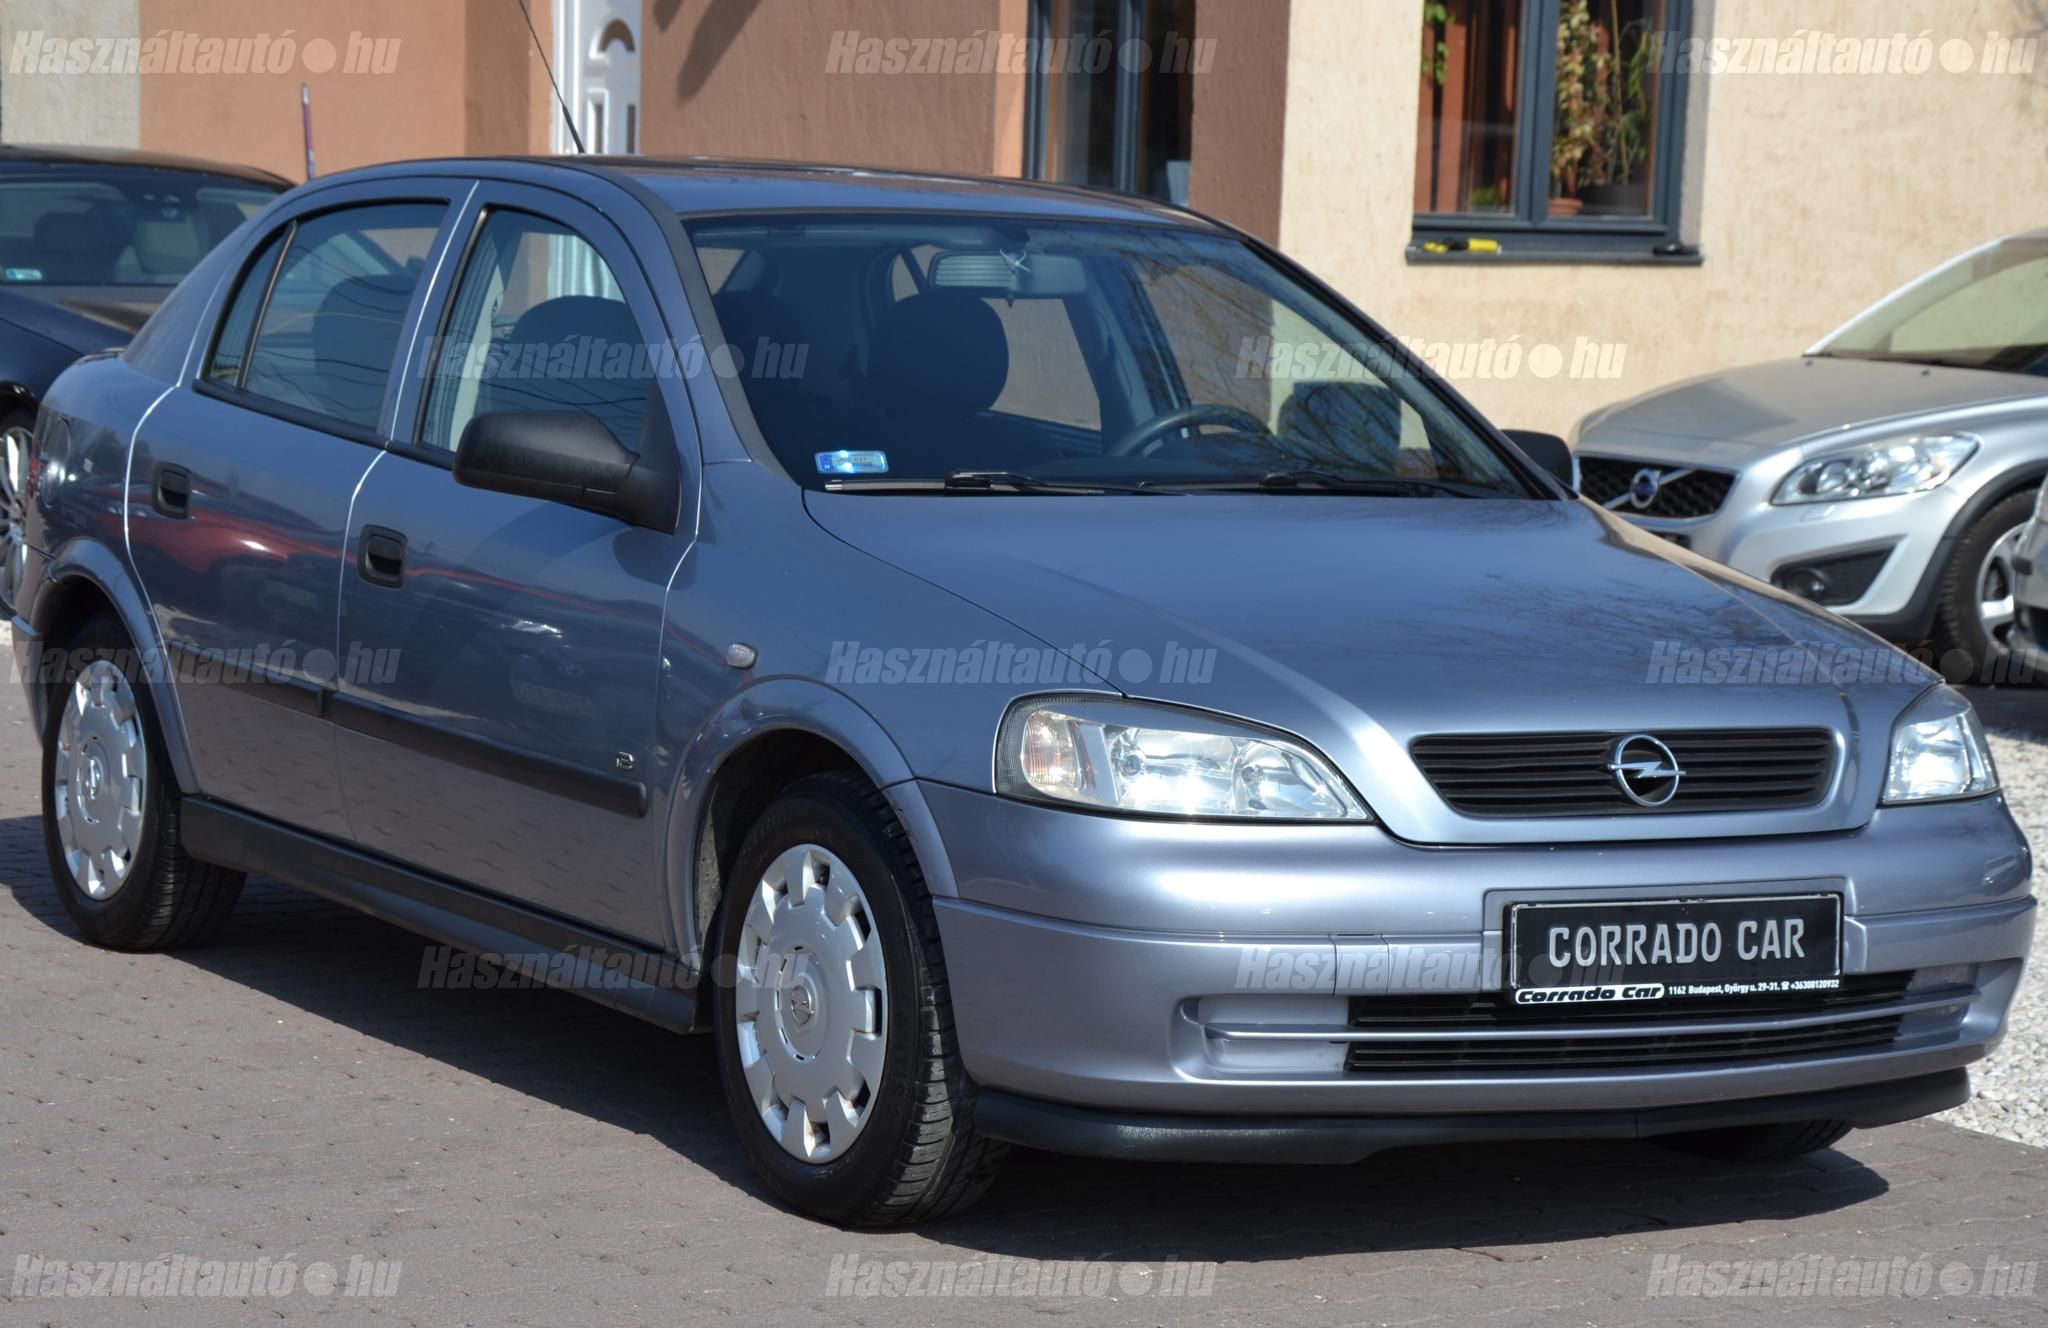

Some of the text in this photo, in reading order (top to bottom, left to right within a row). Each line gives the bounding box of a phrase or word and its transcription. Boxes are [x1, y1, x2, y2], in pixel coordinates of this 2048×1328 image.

[1548, 918, 1805, 968] CORRADO CAR
[1518, 986, 1661, 1003] Corrado Car
[1668, 985, 1686, 995] 1162
[1688, 984, 1723, 995] Budapest,
[1724, 982, 1749, 994] György
[1758, 981, 1780, 991] 29-31.
